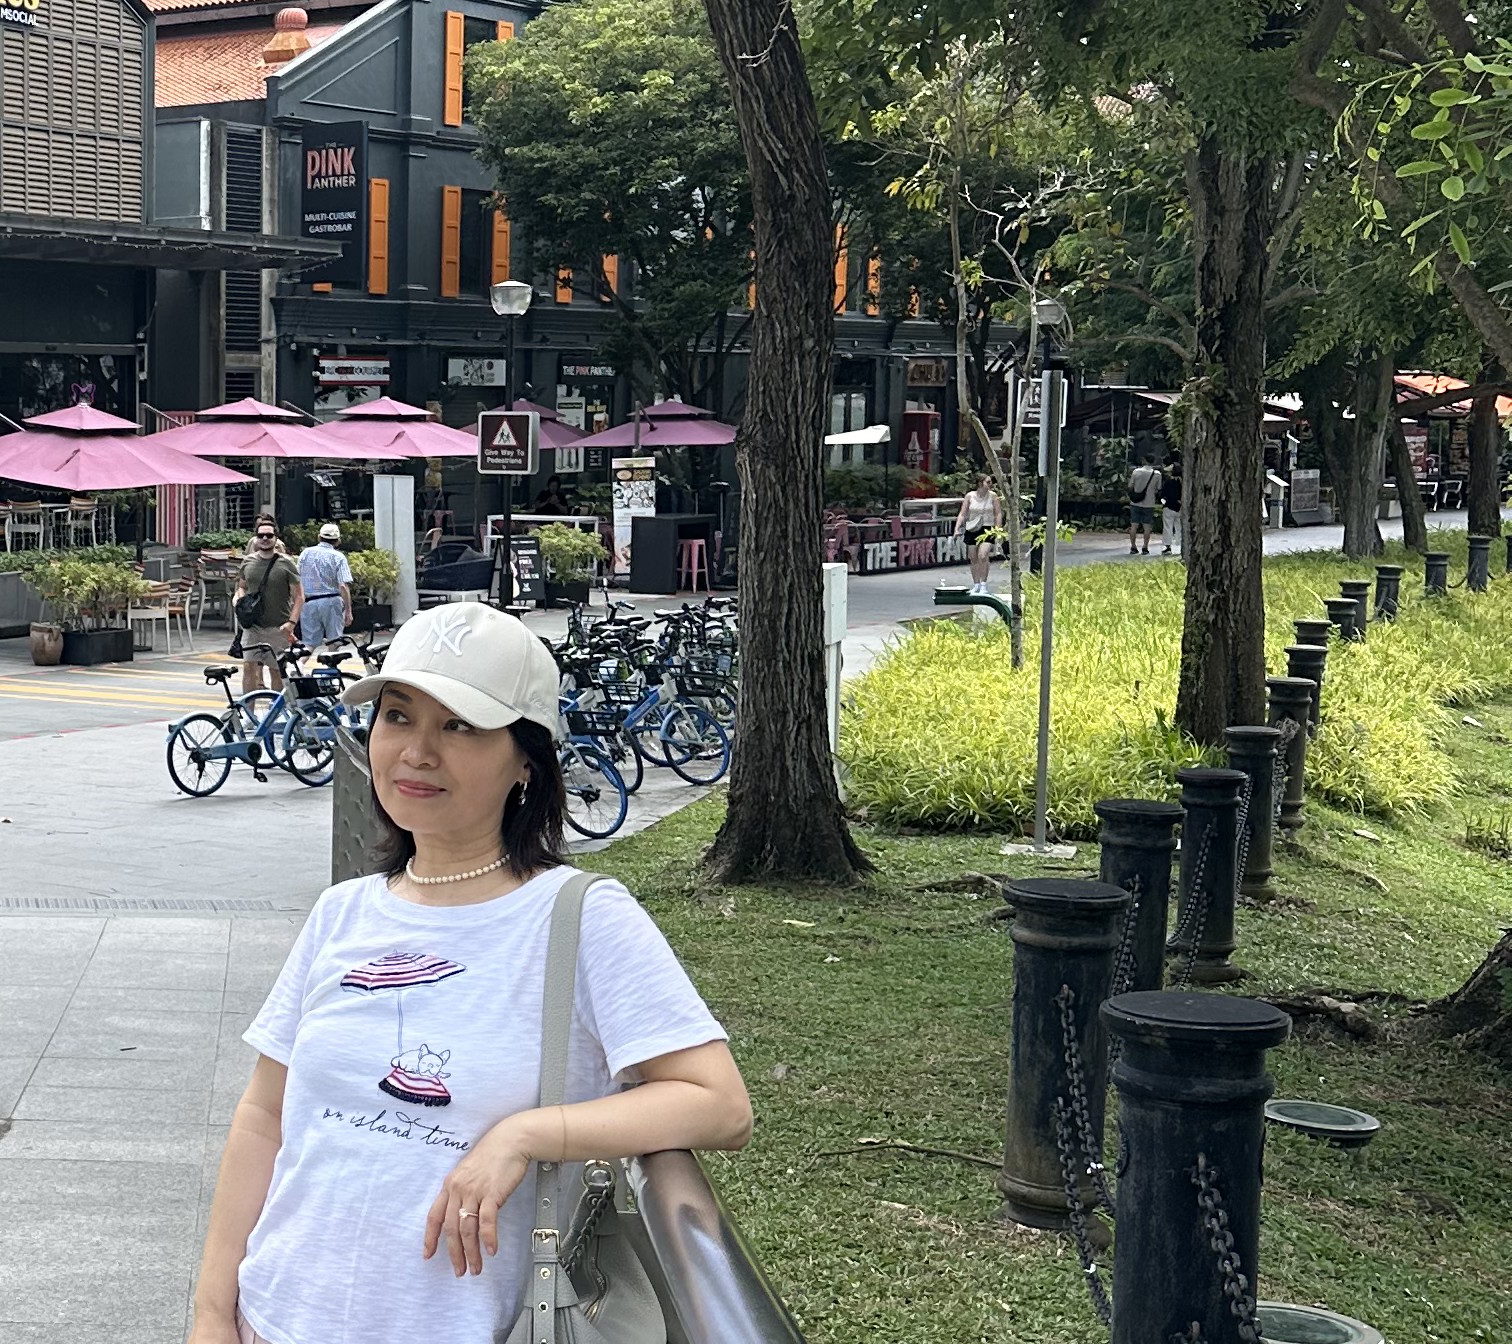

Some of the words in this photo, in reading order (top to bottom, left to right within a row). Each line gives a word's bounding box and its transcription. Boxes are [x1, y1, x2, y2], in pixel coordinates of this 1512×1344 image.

[306, 146, 356, 189] PINK
[304, 210, 356, 222] MULTI-CUISINE
[308, 223, 353, 234] GASTROBAR
[484, 448, 498, 456] Give
[500, 449, 515, 457] Way
[863, 540, 898, 571] THE
[898, 537, 937, 567] PINK
[417, 613, 473, 657] NY
[349, 1109, 414, 1140] island
[411, 1117, 471, 1151] time
